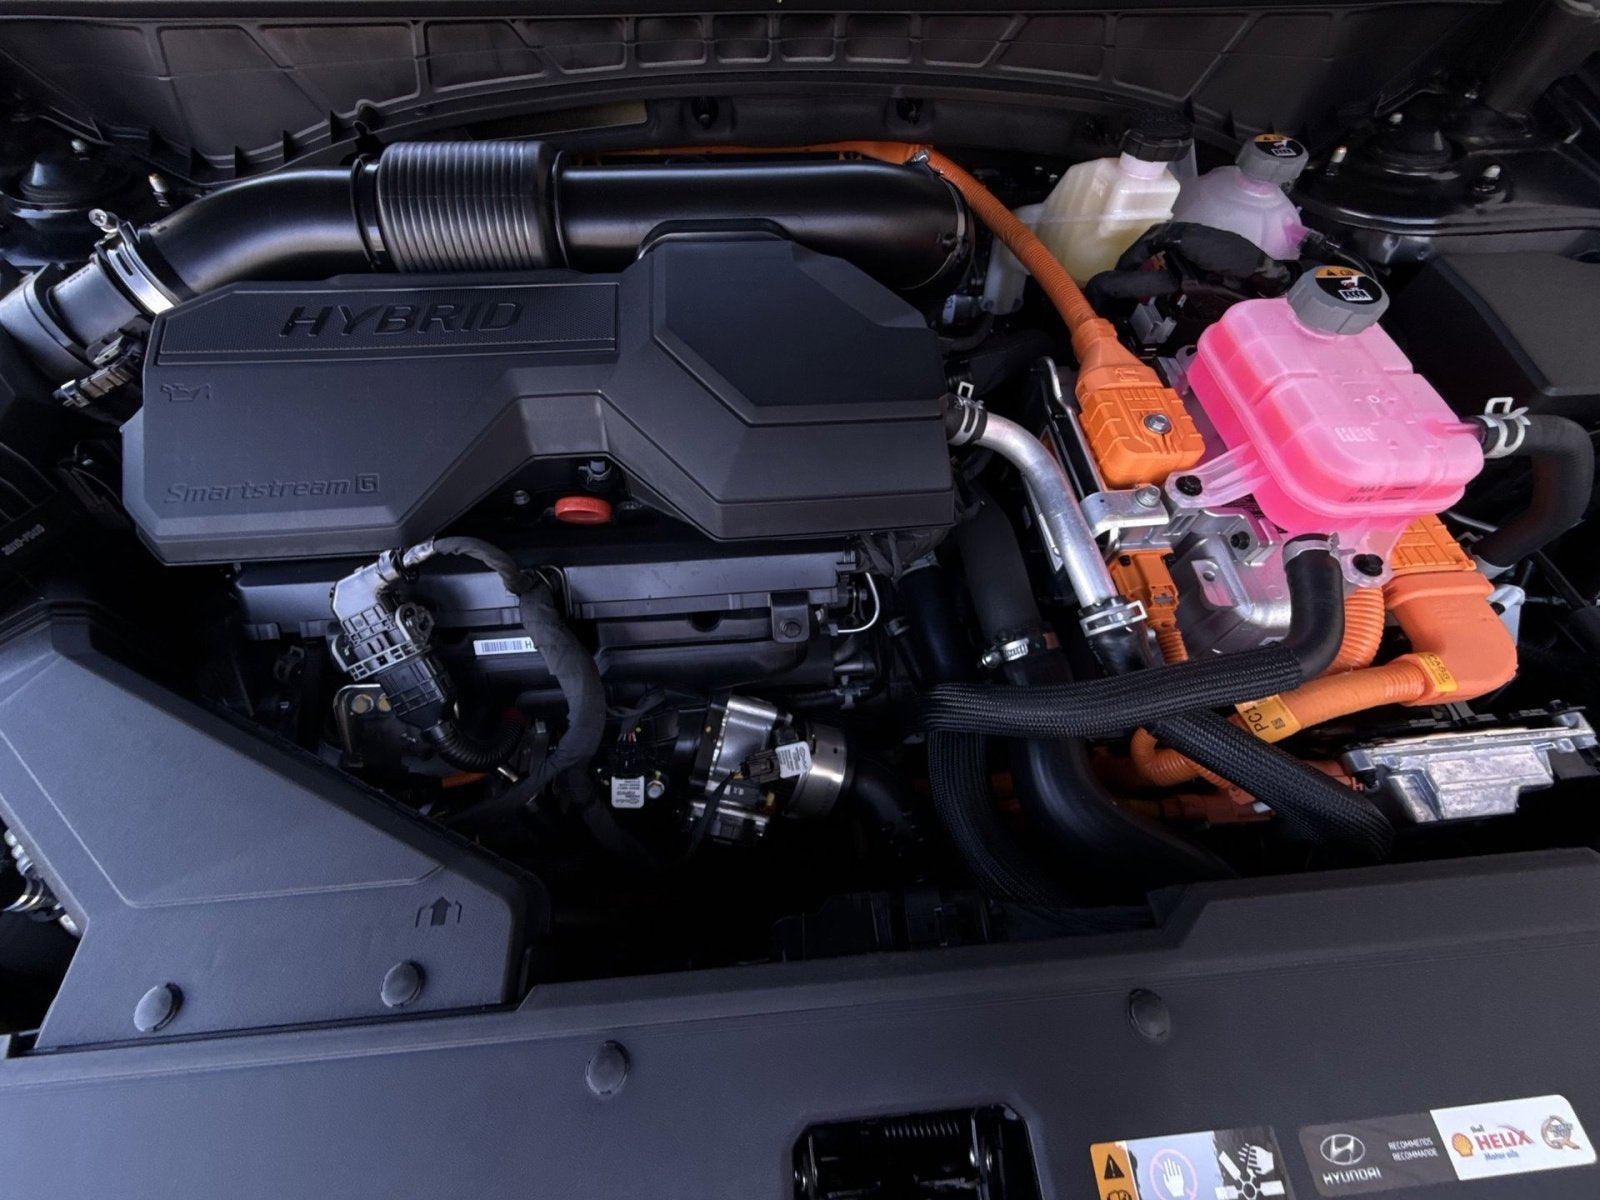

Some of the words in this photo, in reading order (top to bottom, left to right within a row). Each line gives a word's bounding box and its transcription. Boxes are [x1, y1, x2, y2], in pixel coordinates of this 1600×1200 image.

[279, 302, 525, 338] HYBRID
[164, 478, 350, 504] Smartstream
[1243, 704, 1270, 733] PC1
[1474, 1129, 1534, 1151] HELIX
[1322, 1166, 1382, 1185] HYUNDAI
